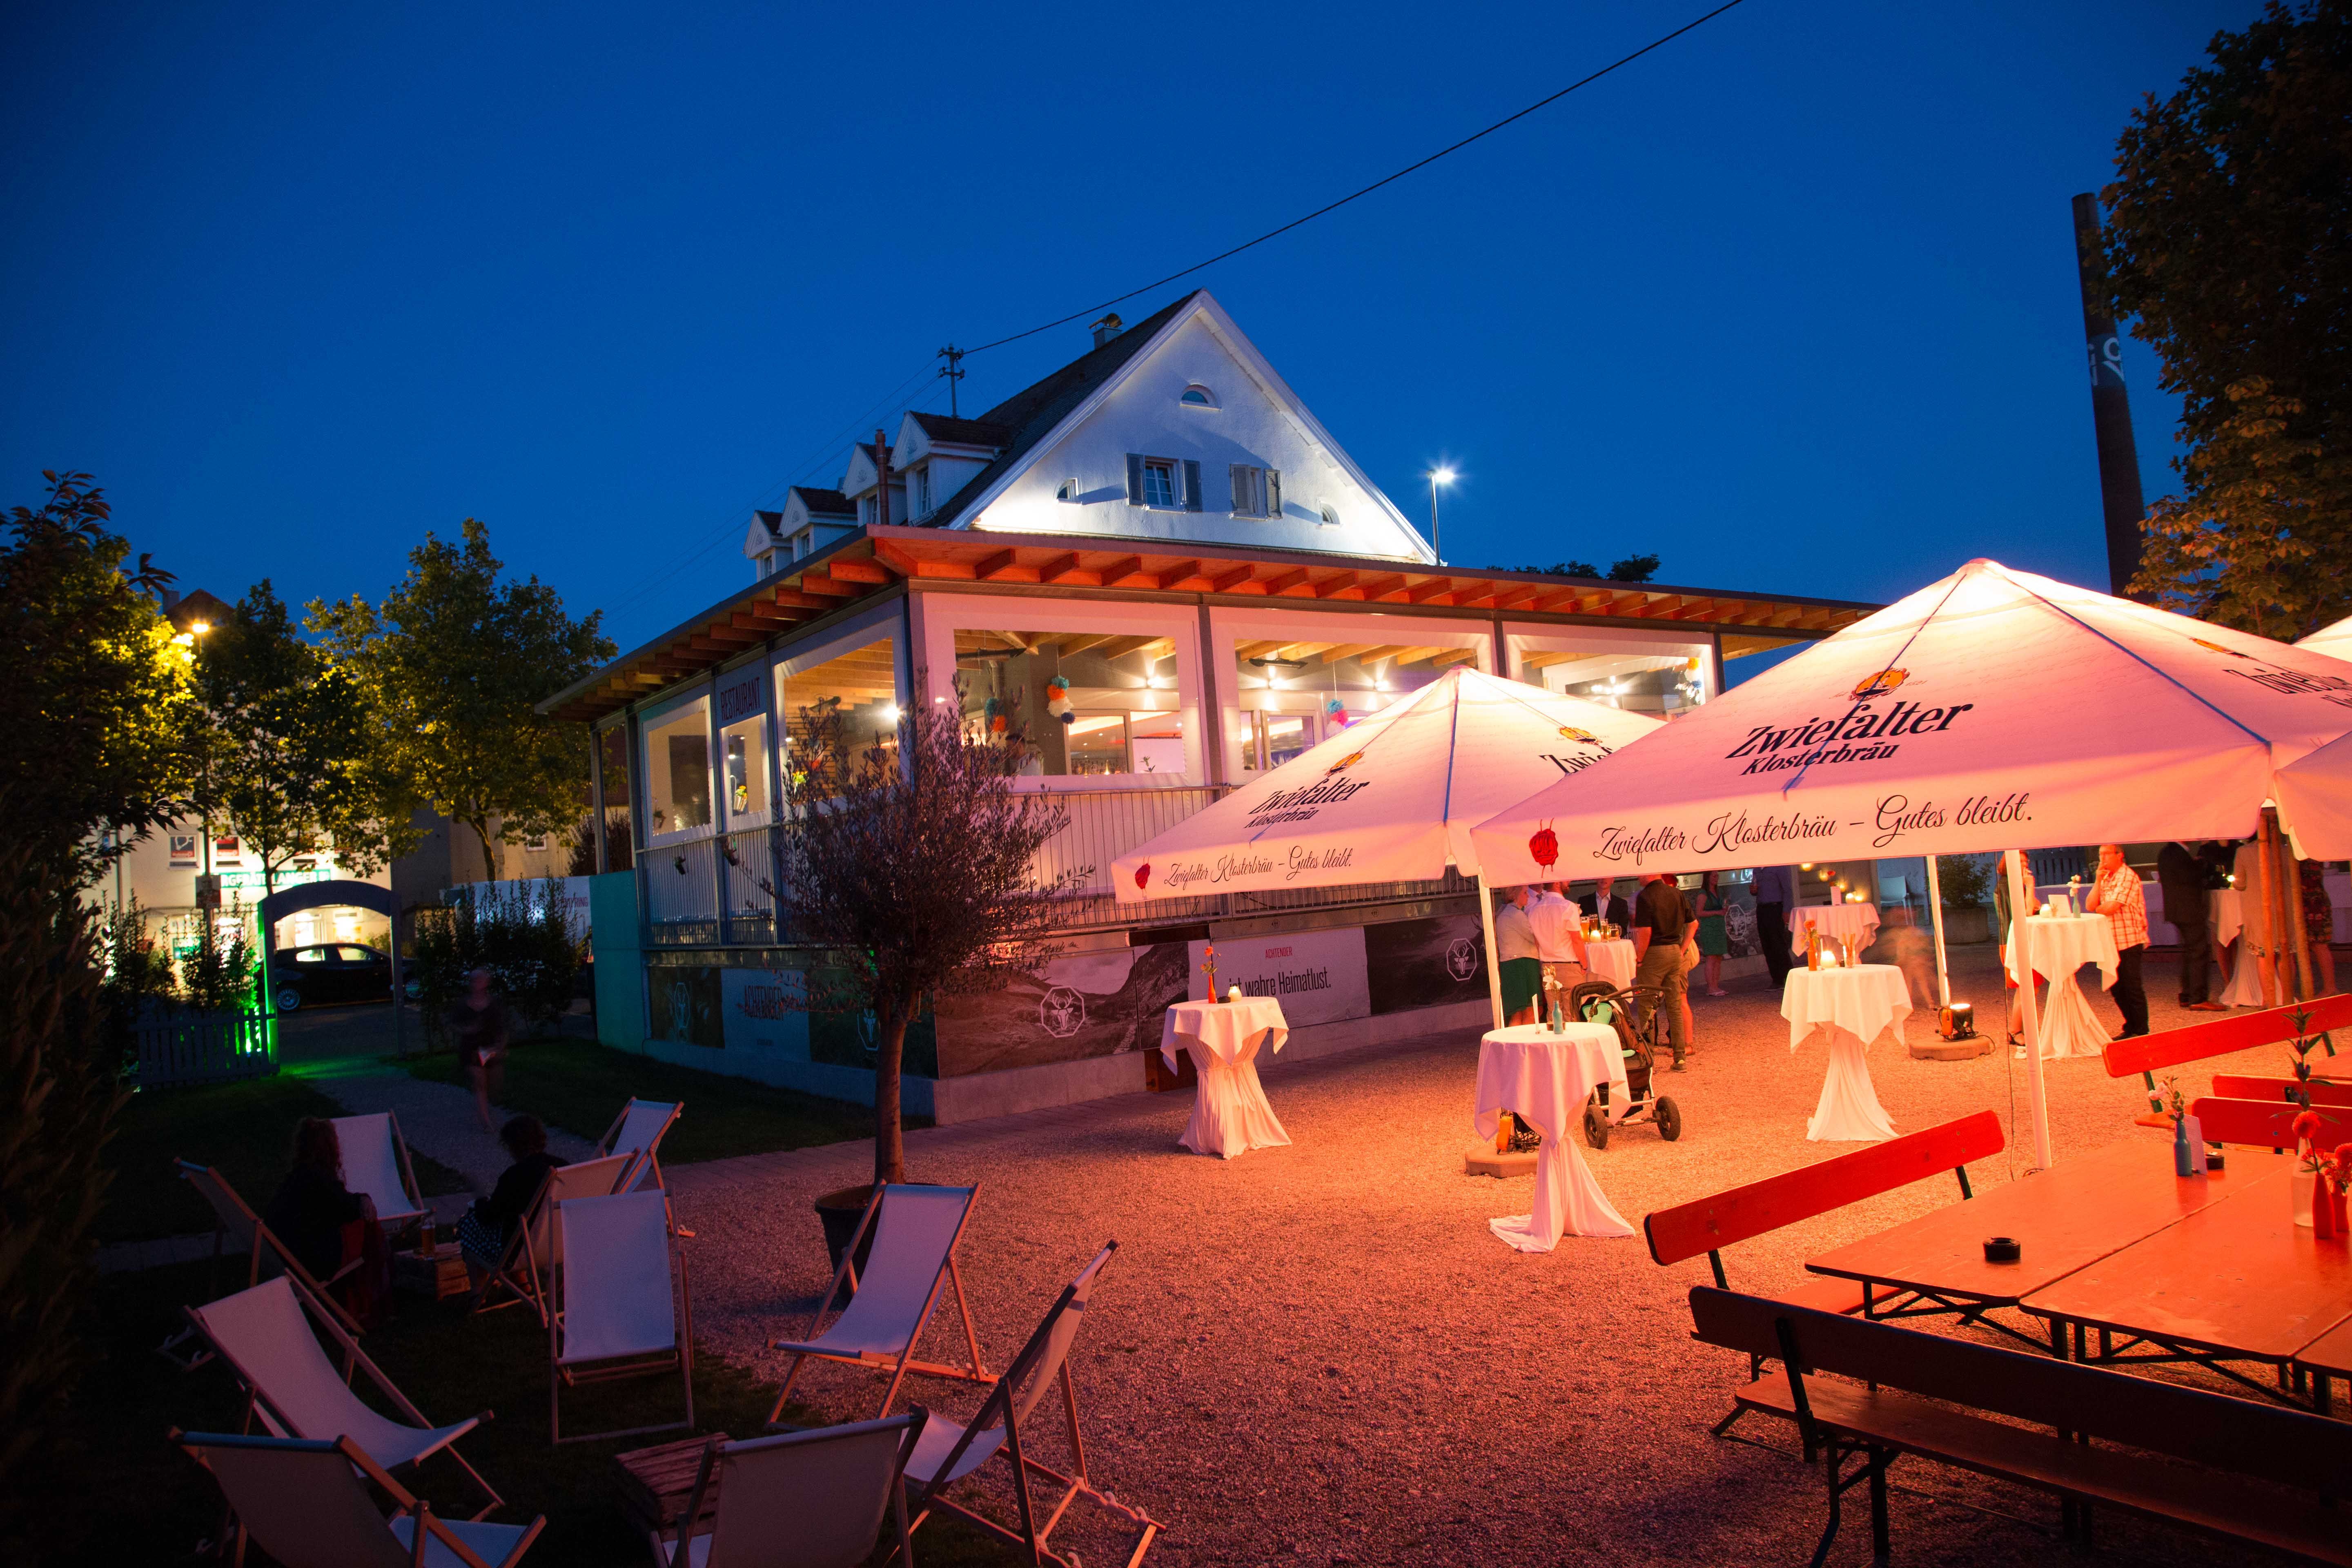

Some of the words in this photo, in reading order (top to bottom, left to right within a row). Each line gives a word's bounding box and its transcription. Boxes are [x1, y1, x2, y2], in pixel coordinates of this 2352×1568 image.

[721, 677, 760, 720] RESTAURANT
[1724, 701, 1973, 759] Zwiefalter
[1740, 741, 1900, 776] Klosterbräu
[1248, 777, 1370, 815] Zwiefalter
[1244, 807, 1320, 829] Klosterbräu
[1593, 826, 1686, 866] Zwiefalter
[1692, 808, 1837, 854] Klosterbräu
[1872, 794, 1948, 849] Gutes
[1954, 792, 2032, 826] bleibt.
[271, 871, 317, 884] LANGER
[1164, 863, 1209, 891] Zwiefalter
[1210, 854, 1273, 883] Klosterbräu
[1285, 845, 1319, 881] Gutes
[1322, 848, 1353, 868] bleibt.
[1265, 946, 1293, 959] ACHTENDER
[1245, 974, 1276, 997] wahre
[1278, 966, 1332, 995] Heimatlust.
